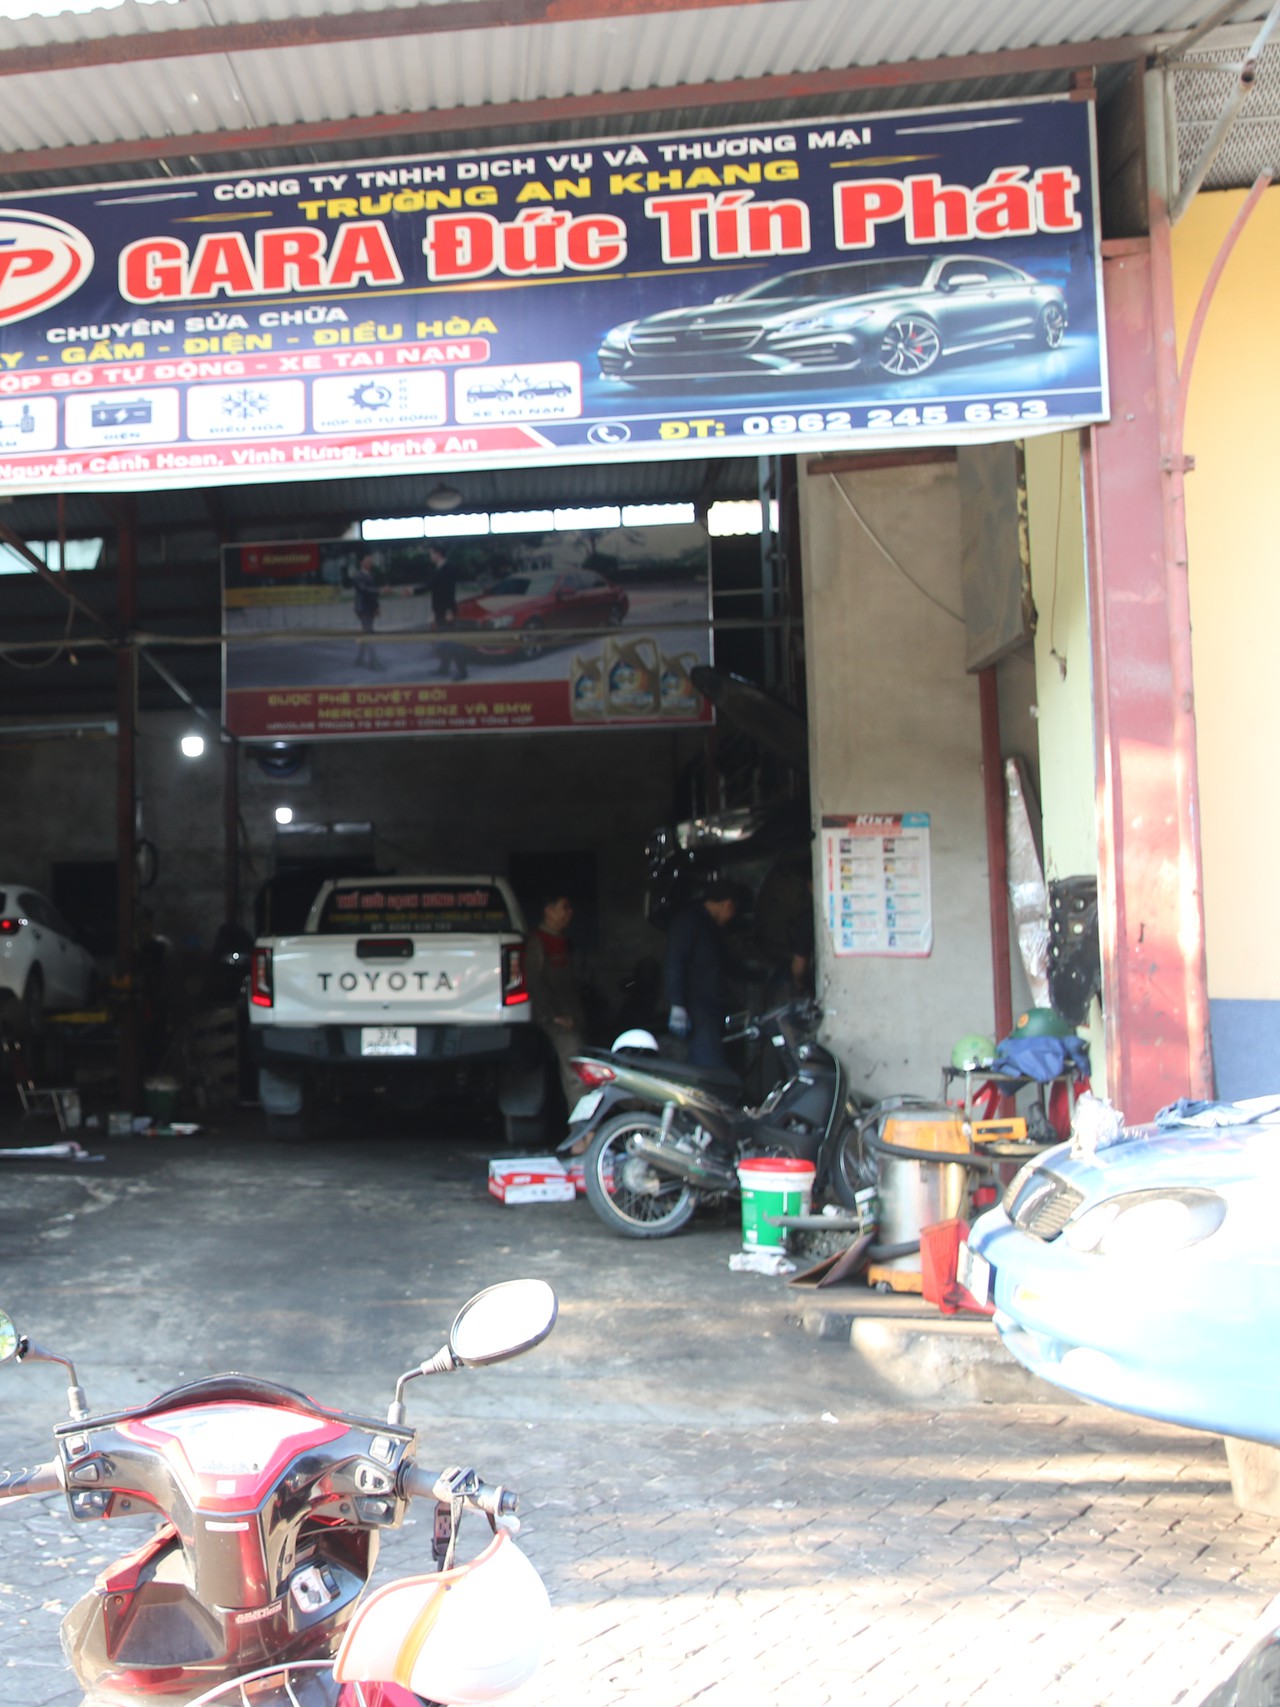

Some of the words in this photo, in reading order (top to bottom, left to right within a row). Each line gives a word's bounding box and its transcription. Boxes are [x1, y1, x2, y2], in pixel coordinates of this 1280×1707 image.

[214, 178, 300, 200] CÔNG
[309, 174, 348, 192] TY
[357, 166, 445, 188] TNHH
[457, 158, 535, 181] DỊCH
[546, 153, 593, 172] VỤ
[603, 144, 649, 166] VÀ
[658, 132, 797, 161] THƯƠNG
[807, 127, 871, 150] MẠI
[298, 185, 497, 221] TRƯỜNG
[516, 177, 591, 203] AN
[609, 159, 799, 195] KHANG
[118, 219, 404, 304] GARA
[423, 206, 627, 282] Đức
[645, 189, 811, 265] Tín
[833, 166, 1082, 250] Phát
[46, 319, 174, 344] CHUYÊN
[185, 312, 248, 332] SỬA
[258, 306, 349, 327] CHỮA
[183, 333, 273, 357] ĐIỆN
[312, 321, 404, 347] ĐIỀU
[416, 316, 498, 340] HÒA
[50, 365, 94, 388] SỐ
[101, 366, 147, 387] TỰ
[153, 359, 246, 384] ĐỘNG
[278, 353, 322, 372] XE
[332, 347, 384, 367] TAI
[395, 343, 471, 365] NẠN
[659, 419, 725, 441] ĐT:
[742, 410, 852, 436] 0962
[866, 404, 948, 429] 245
[964, 398, 1048, 422] 633
[231, 446, 285, 464] Vinh
[370, 437, 438, 458] Nghệ
[444, 436, 478, 453] An
[317, 971, 454, 992] TOYOTA
